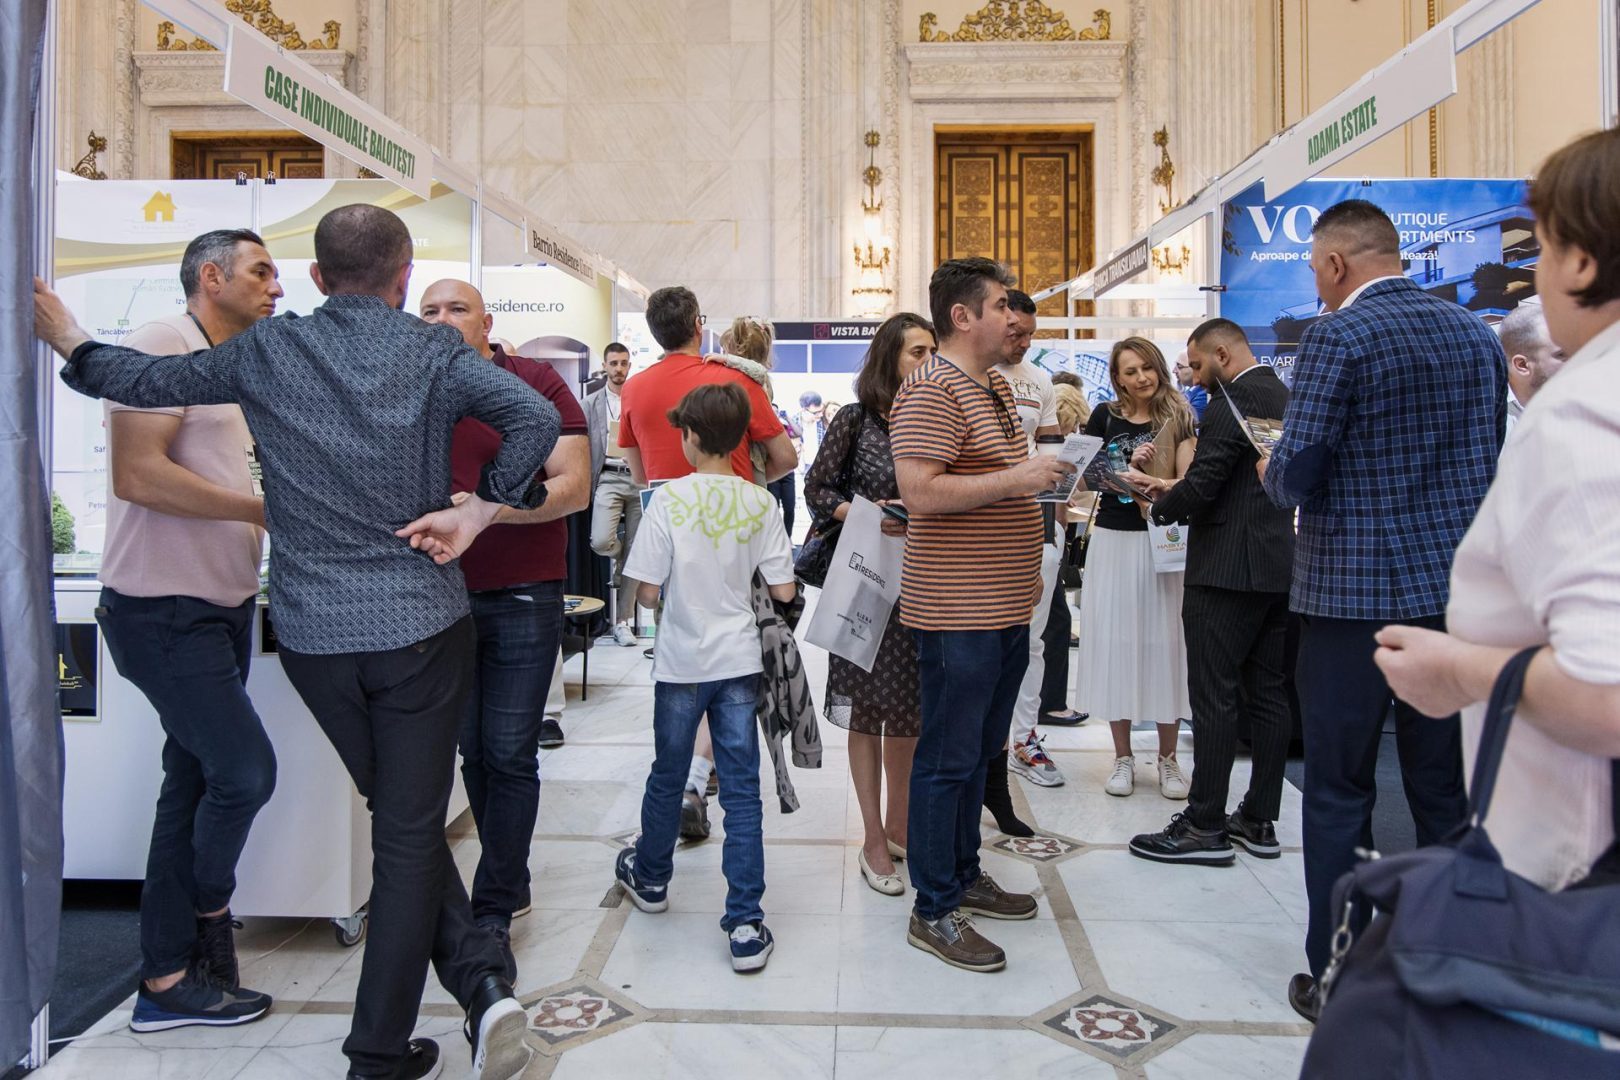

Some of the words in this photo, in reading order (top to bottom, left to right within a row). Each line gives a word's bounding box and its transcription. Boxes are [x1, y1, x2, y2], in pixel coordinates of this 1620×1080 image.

[264, 65, 299, 113] CASE
[300, 87, 368, 153] INDIVIDUALE
[1308, 121, 1340, 165] ADAMA
[1341, 96, 1378, 145] ESTATE
[1246, 204, 1321, 244] VO
[1388, 213, 1448, 228] UTIQUE
[412, 238, 432, 247] ATE
[1400, 230, 1476, 243] RTMENTS
[532, 230, 552, 258] Barrio
[553, 241, 579, 272] Residence
[1250, 250, 1299, 263] Aproape
[1301, 250, 1312, 261] d
[1400, 250, 1438, 261] ntează!
[484, 299, 565, 312] esidence.ro
[831, 326, 860, 336] VISTA
